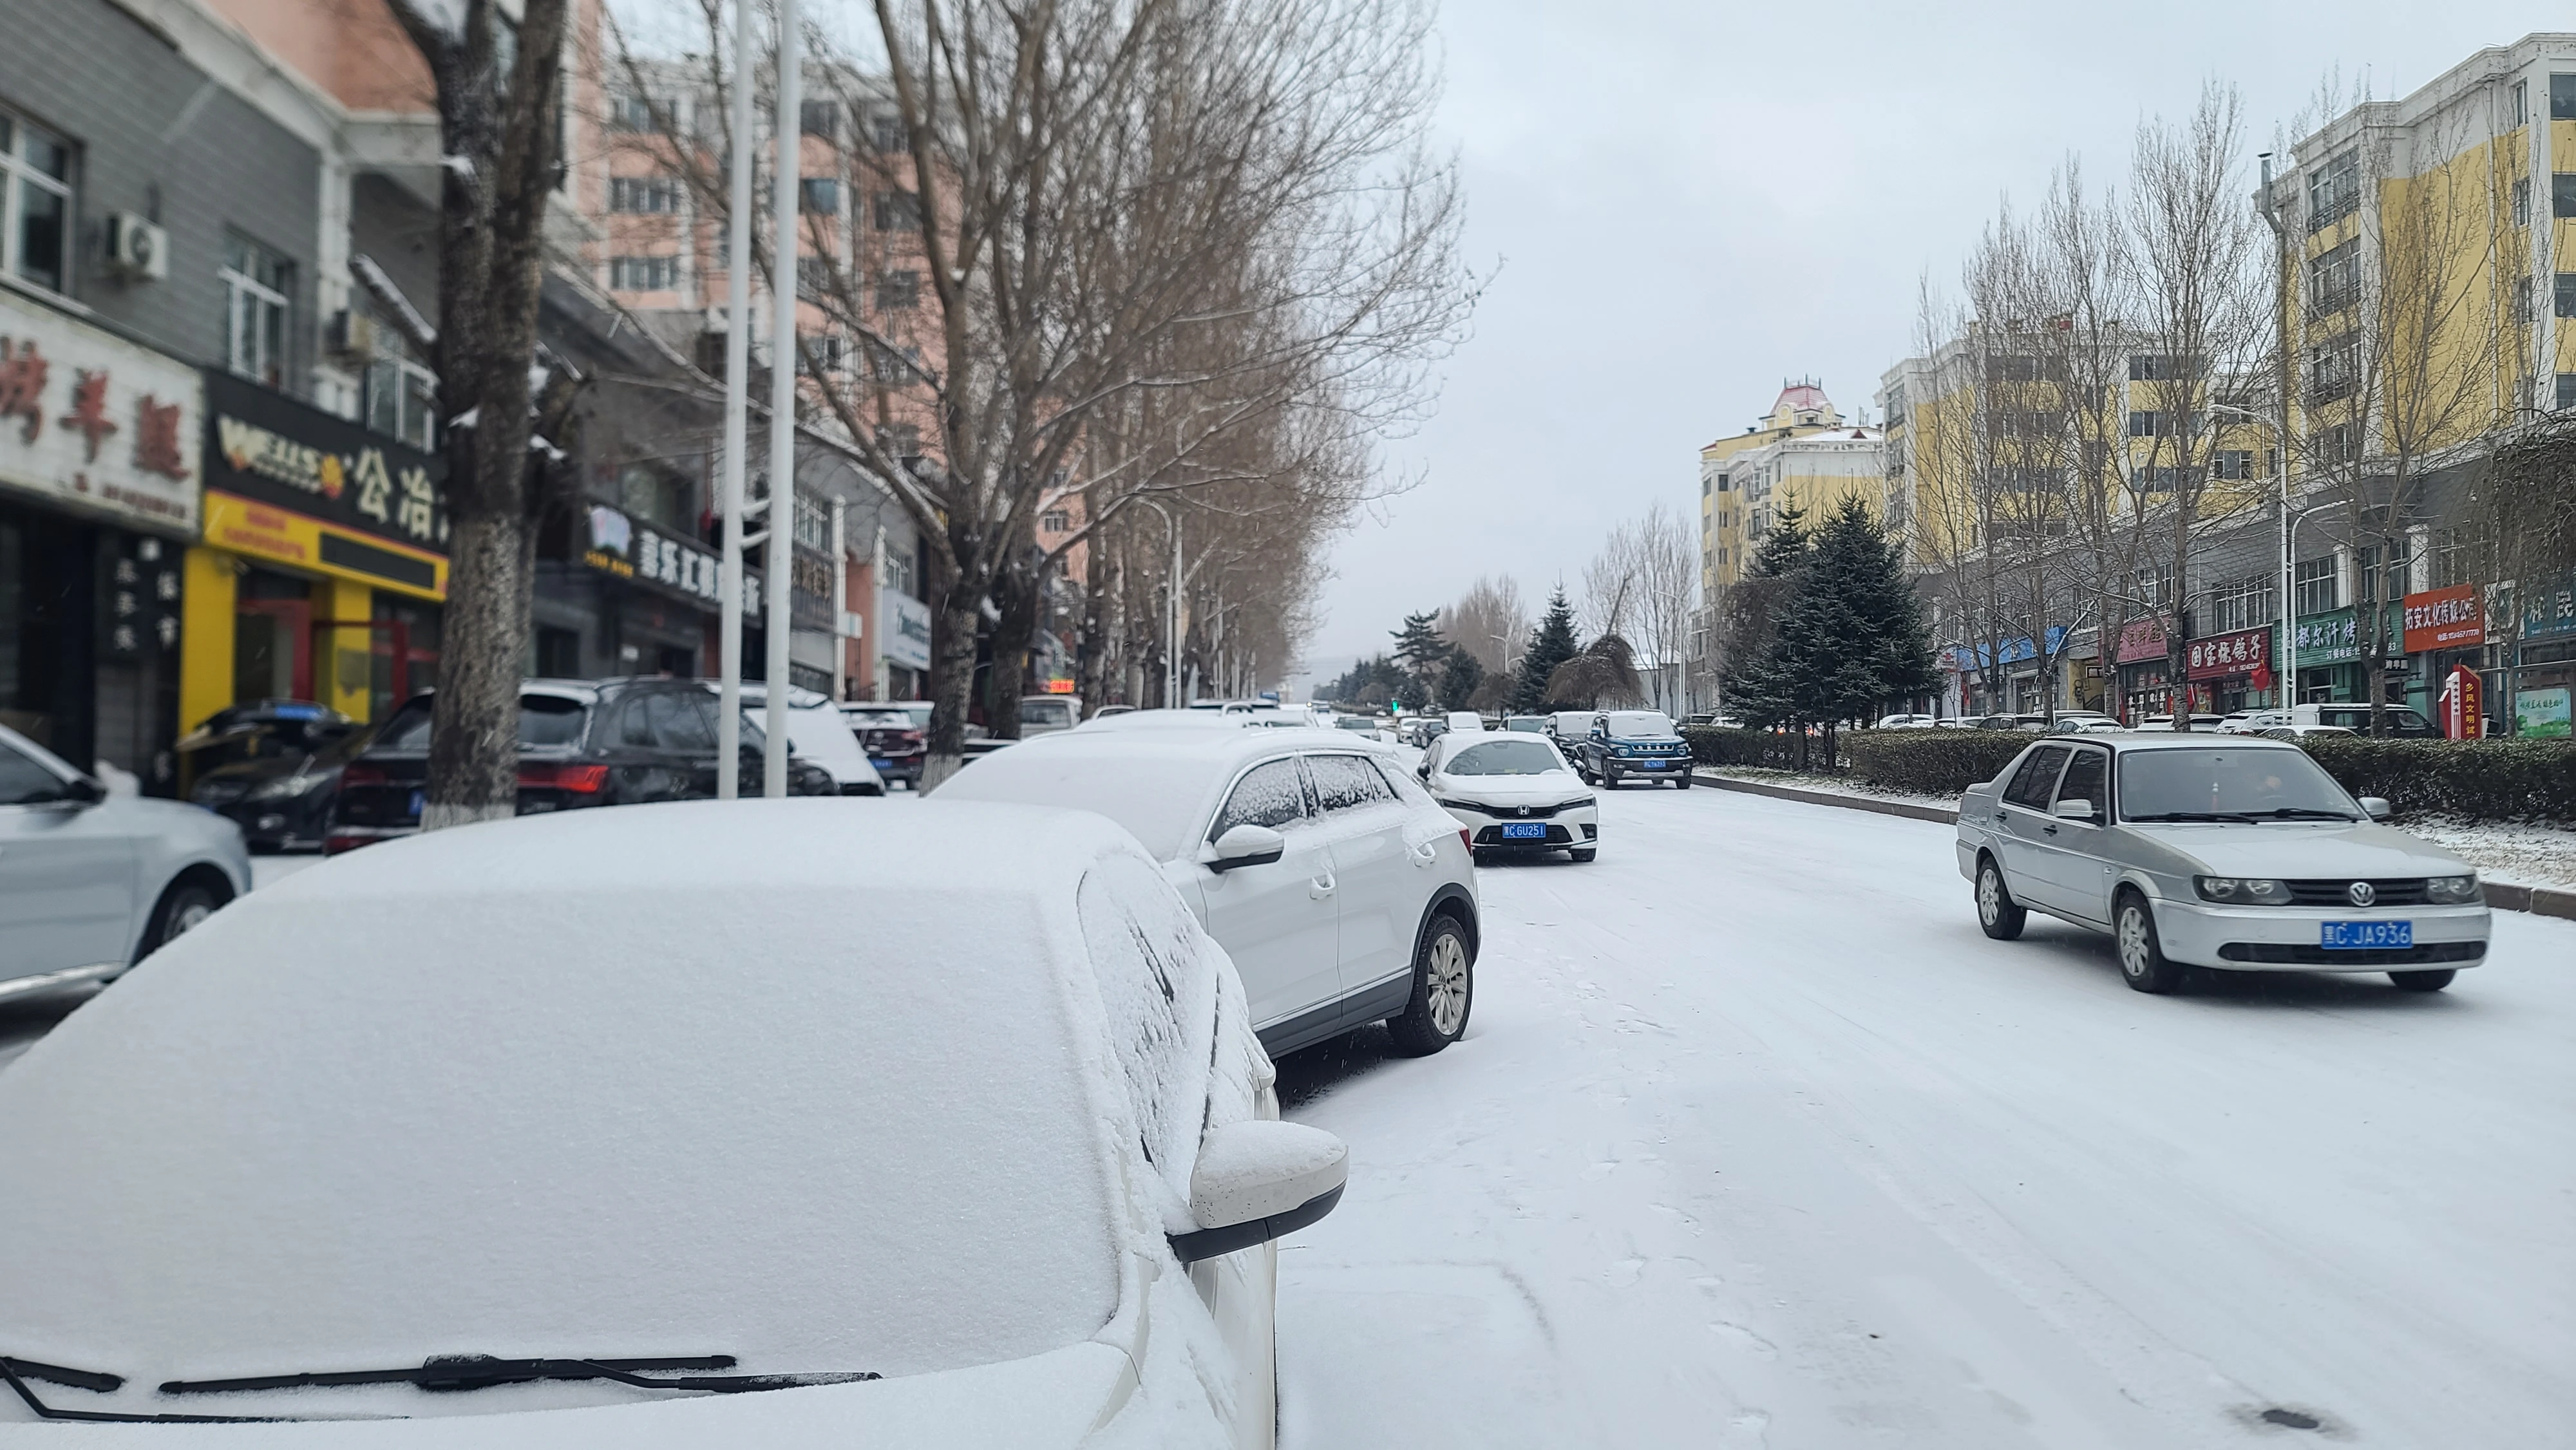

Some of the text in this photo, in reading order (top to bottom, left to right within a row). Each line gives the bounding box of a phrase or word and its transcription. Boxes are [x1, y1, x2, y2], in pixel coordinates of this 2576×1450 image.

[2405, 598, 2477, 630] 拓安文化传媒公司
[2192, 634, 2261, 668] 国宝烧鸽子
[2465, 683, 2475, 739] 乡风文明试
